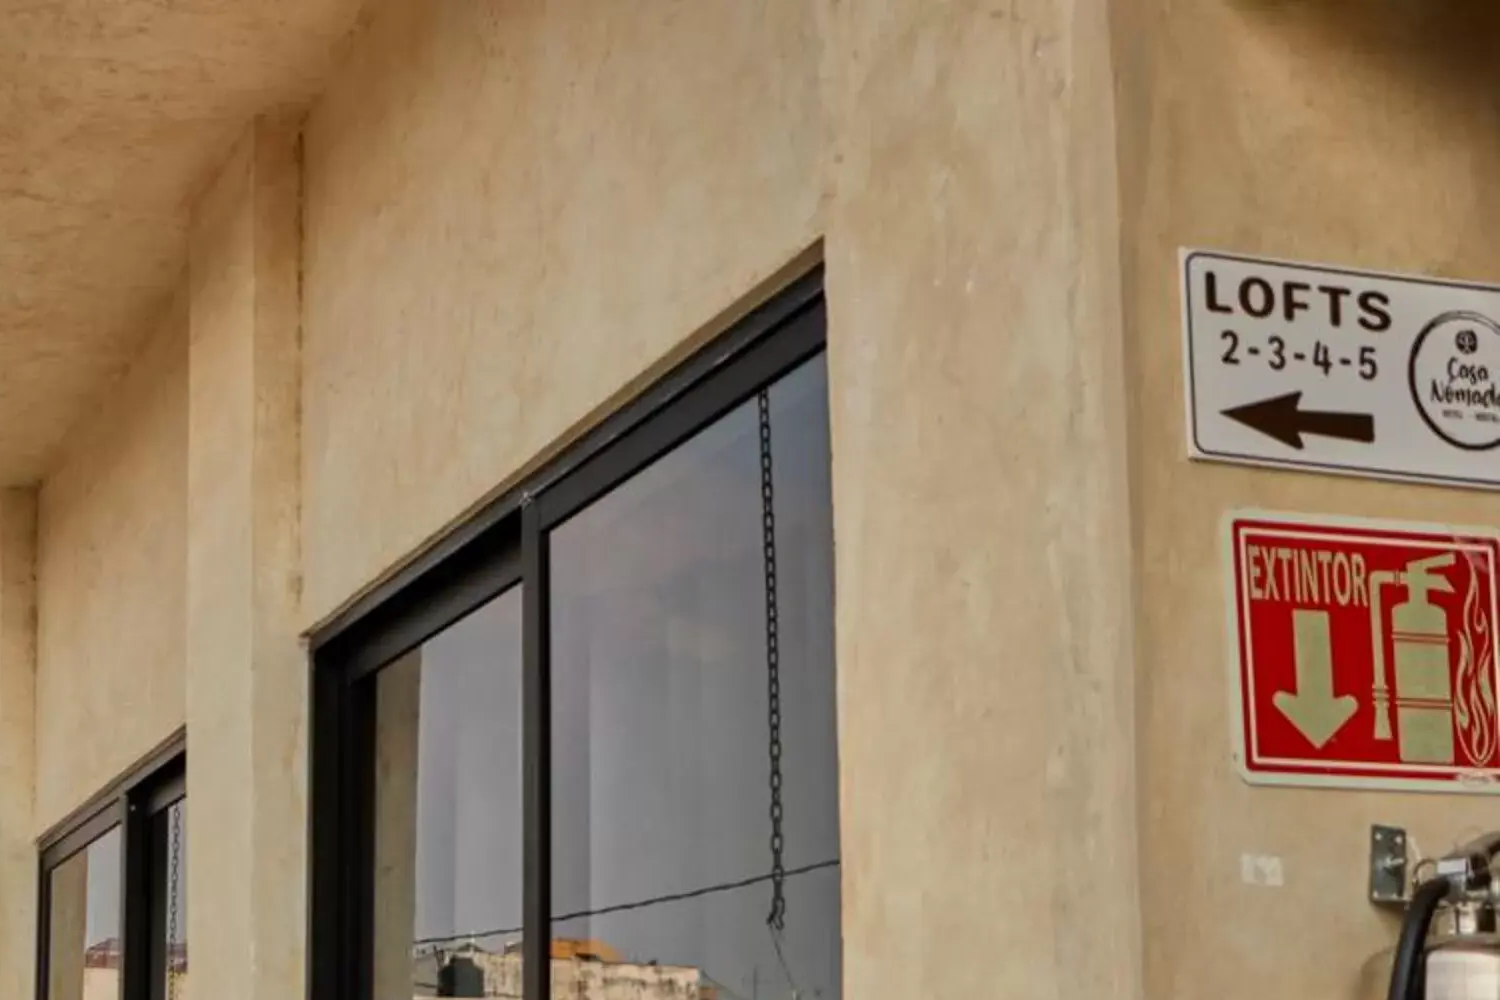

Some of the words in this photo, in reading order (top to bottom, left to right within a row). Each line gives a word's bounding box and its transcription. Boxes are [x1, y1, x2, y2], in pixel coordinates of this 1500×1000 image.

[1204, 271, 1393, 333] LOFTS
[1220, 330, 1379, 381] 2-3-4-5
[1447, 356, 1489, 385] Casa
[1247, 545, 1370, 607] EXTINTOR
